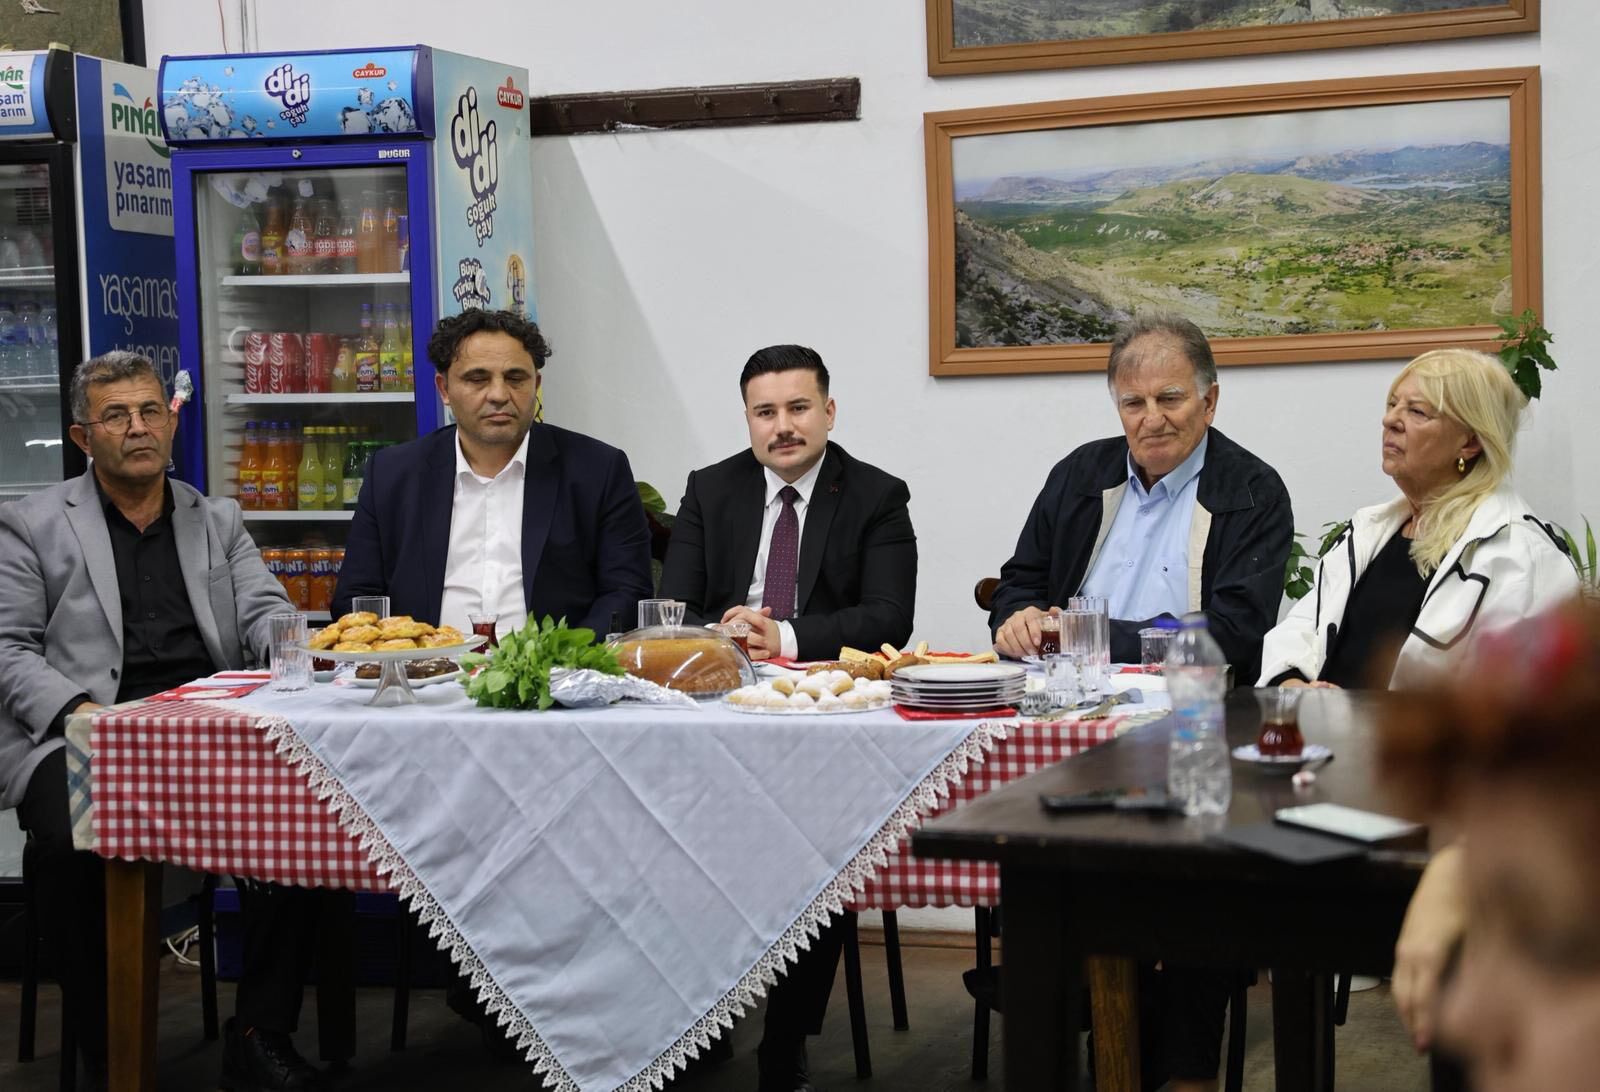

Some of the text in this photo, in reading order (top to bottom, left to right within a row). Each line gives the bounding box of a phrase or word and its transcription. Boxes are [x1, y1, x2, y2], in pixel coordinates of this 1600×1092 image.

[0, 107, 26, 117] arım
[111, 102, 162, 137] PINA
[114, 160, 171, 190] yaşam
[467, 194, 496, 226] soğuk
[475, 216, 493, 246] çay
